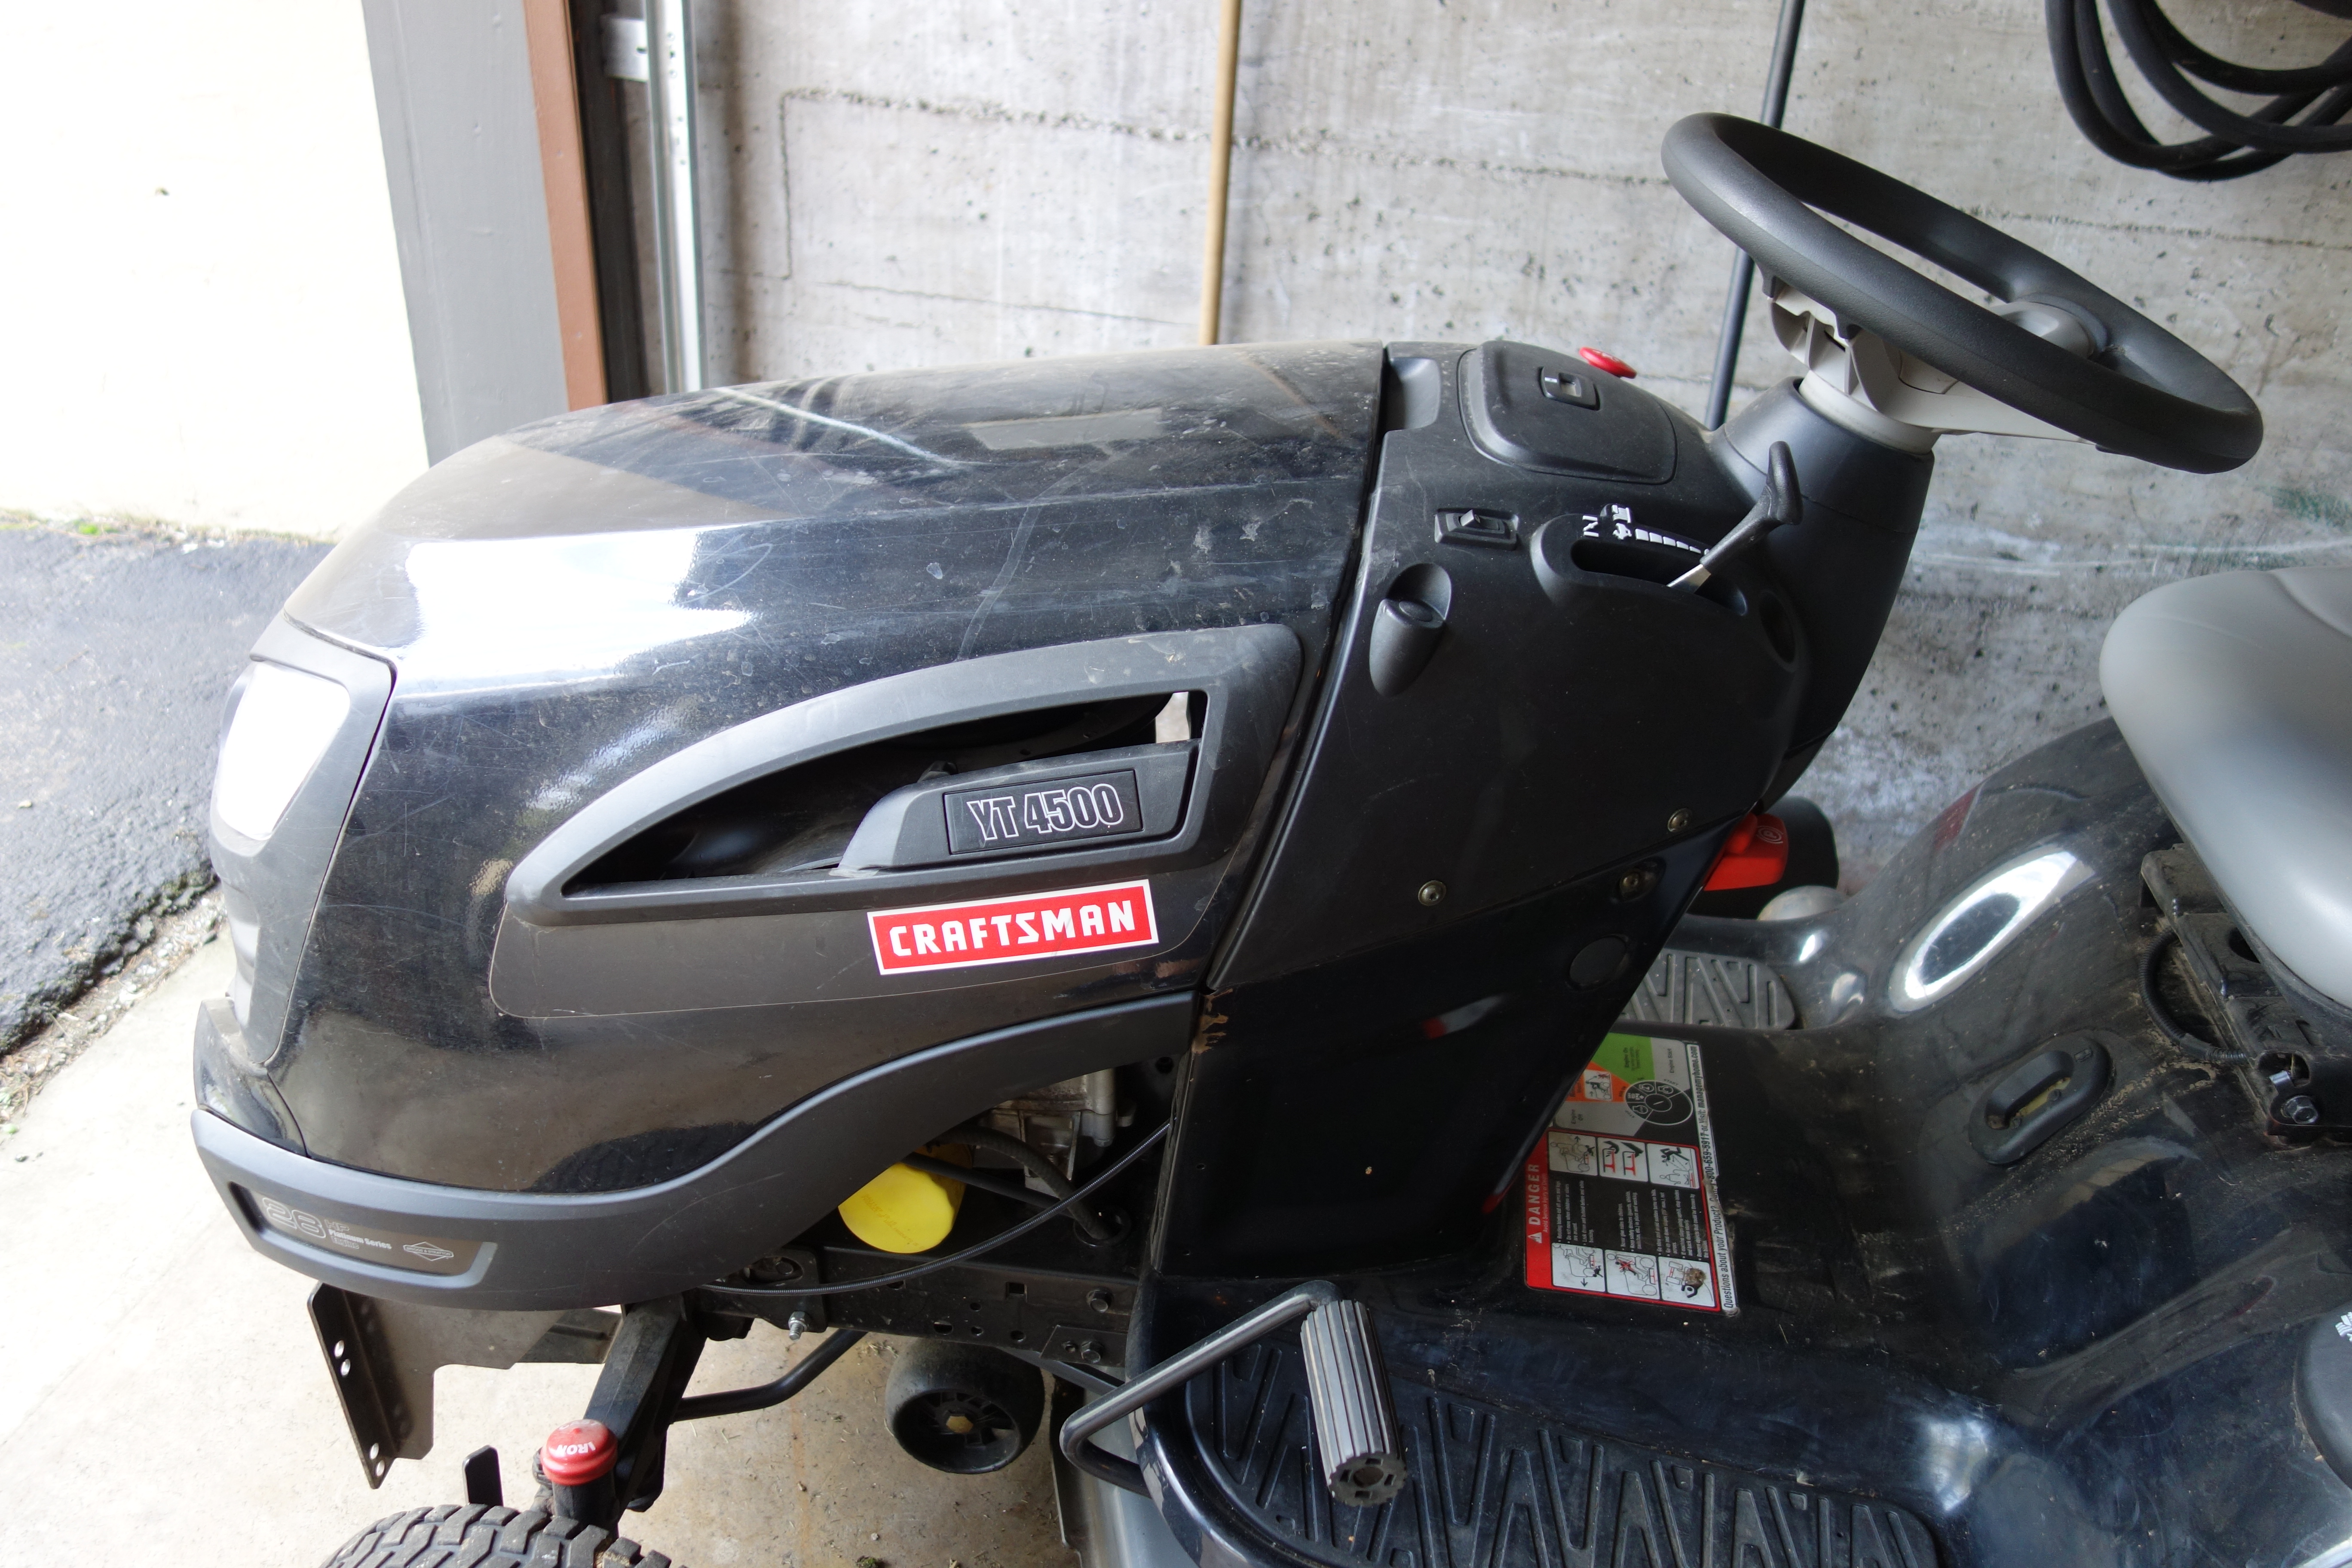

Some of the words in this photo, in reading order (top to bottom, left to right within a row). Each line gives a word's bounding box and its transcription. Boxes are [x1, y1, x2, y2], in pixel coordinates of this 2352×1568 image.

[966, 796, 1020, 841] YT
[1023, 783, 1124, 834] 4500
[889, 900, 1136, 957] CRAFTSMAN
[1690, 1046, 1705, 1108] managemyhome.com
[1528, 1164, 1540, 1225] DANGER
[262, 1197, 326, 1238] 28
[324, 1219, 350, 1231] HP
[1710, 1206, 1723, 1234] Product?
[328, 1229, 364, 1244] Platinum
[364, 1237, 392, 1250] Series
[331, 1235, 360, 1250] Engine
[1716, 1236, 1727, 1251] your
[1718, 1253, 1729, 1272] about
[1722, 1274, 1733, 1308] Questions
[555, 1441, 596, 1457] IRON
